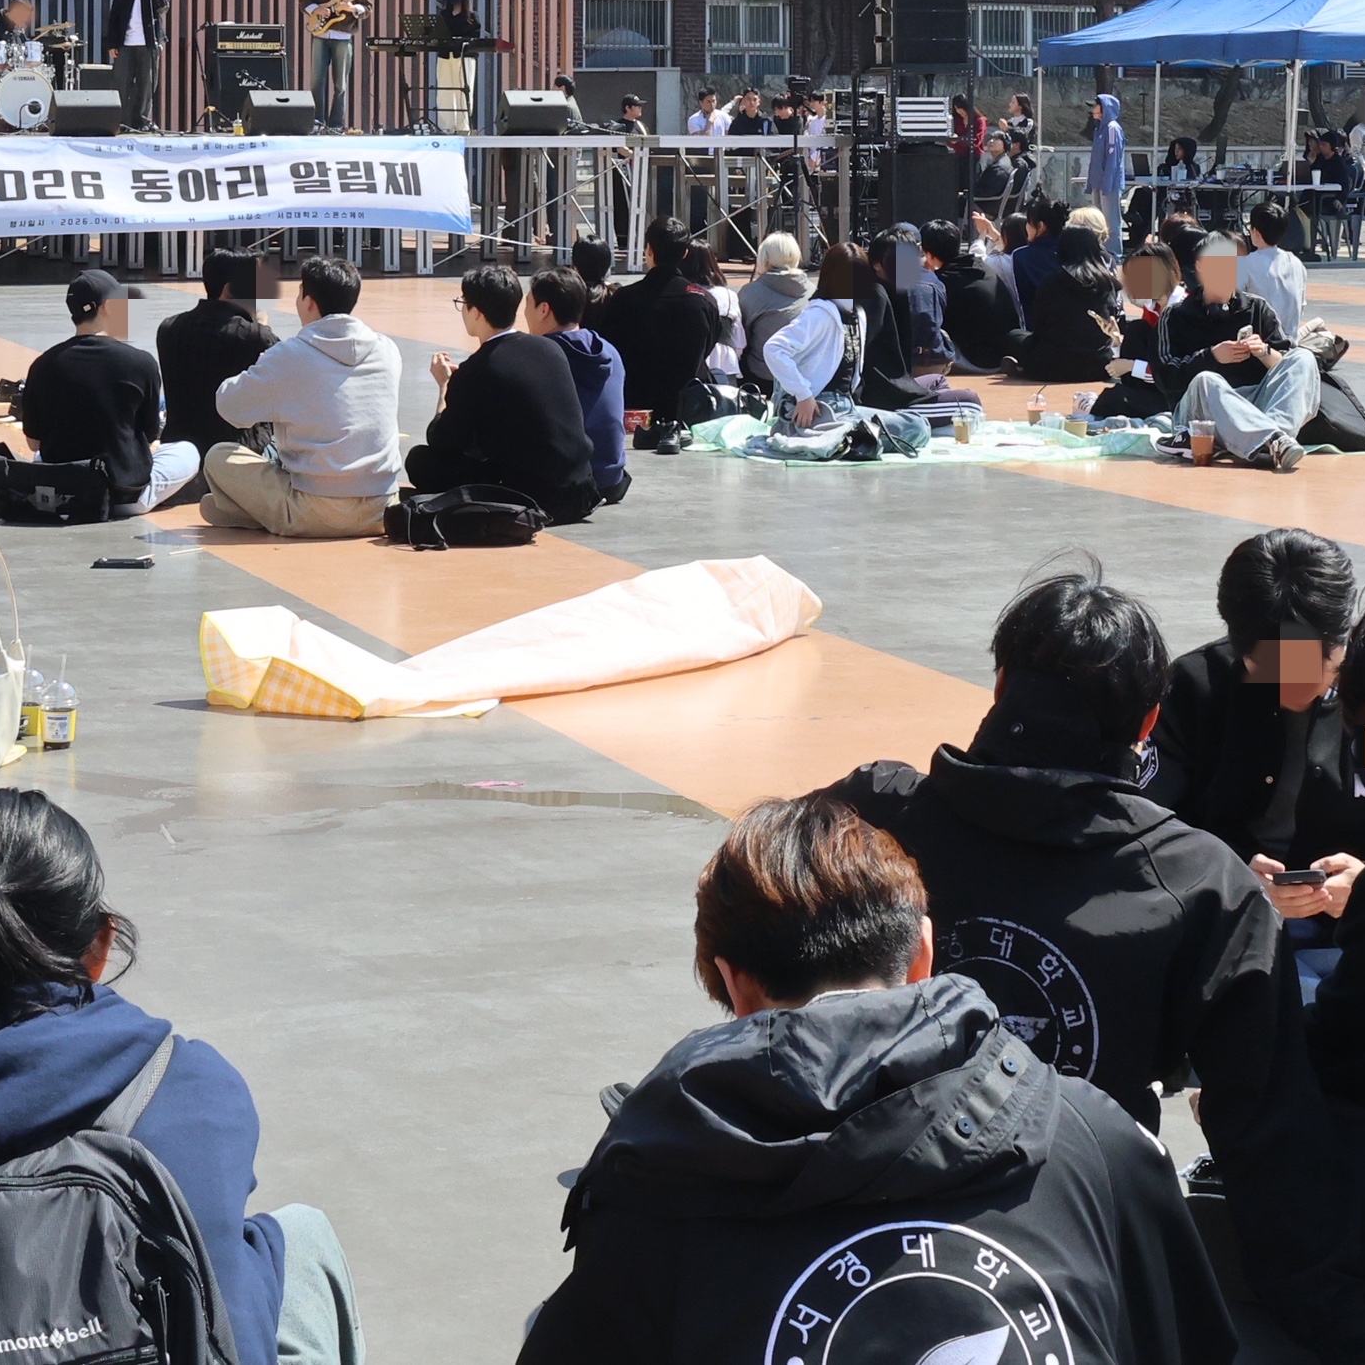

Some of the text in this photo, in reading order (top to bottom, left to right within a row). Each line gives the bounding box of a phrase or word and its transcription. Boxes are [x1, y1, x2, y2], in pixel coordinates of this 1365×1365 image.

[131, 165, 269, 202] 동아리
[288, 160, 422, 197] 알림제
[60, 217, 125, 226] 2026.04.01
[789, 1233, 1051, 1344] 서경대학교
